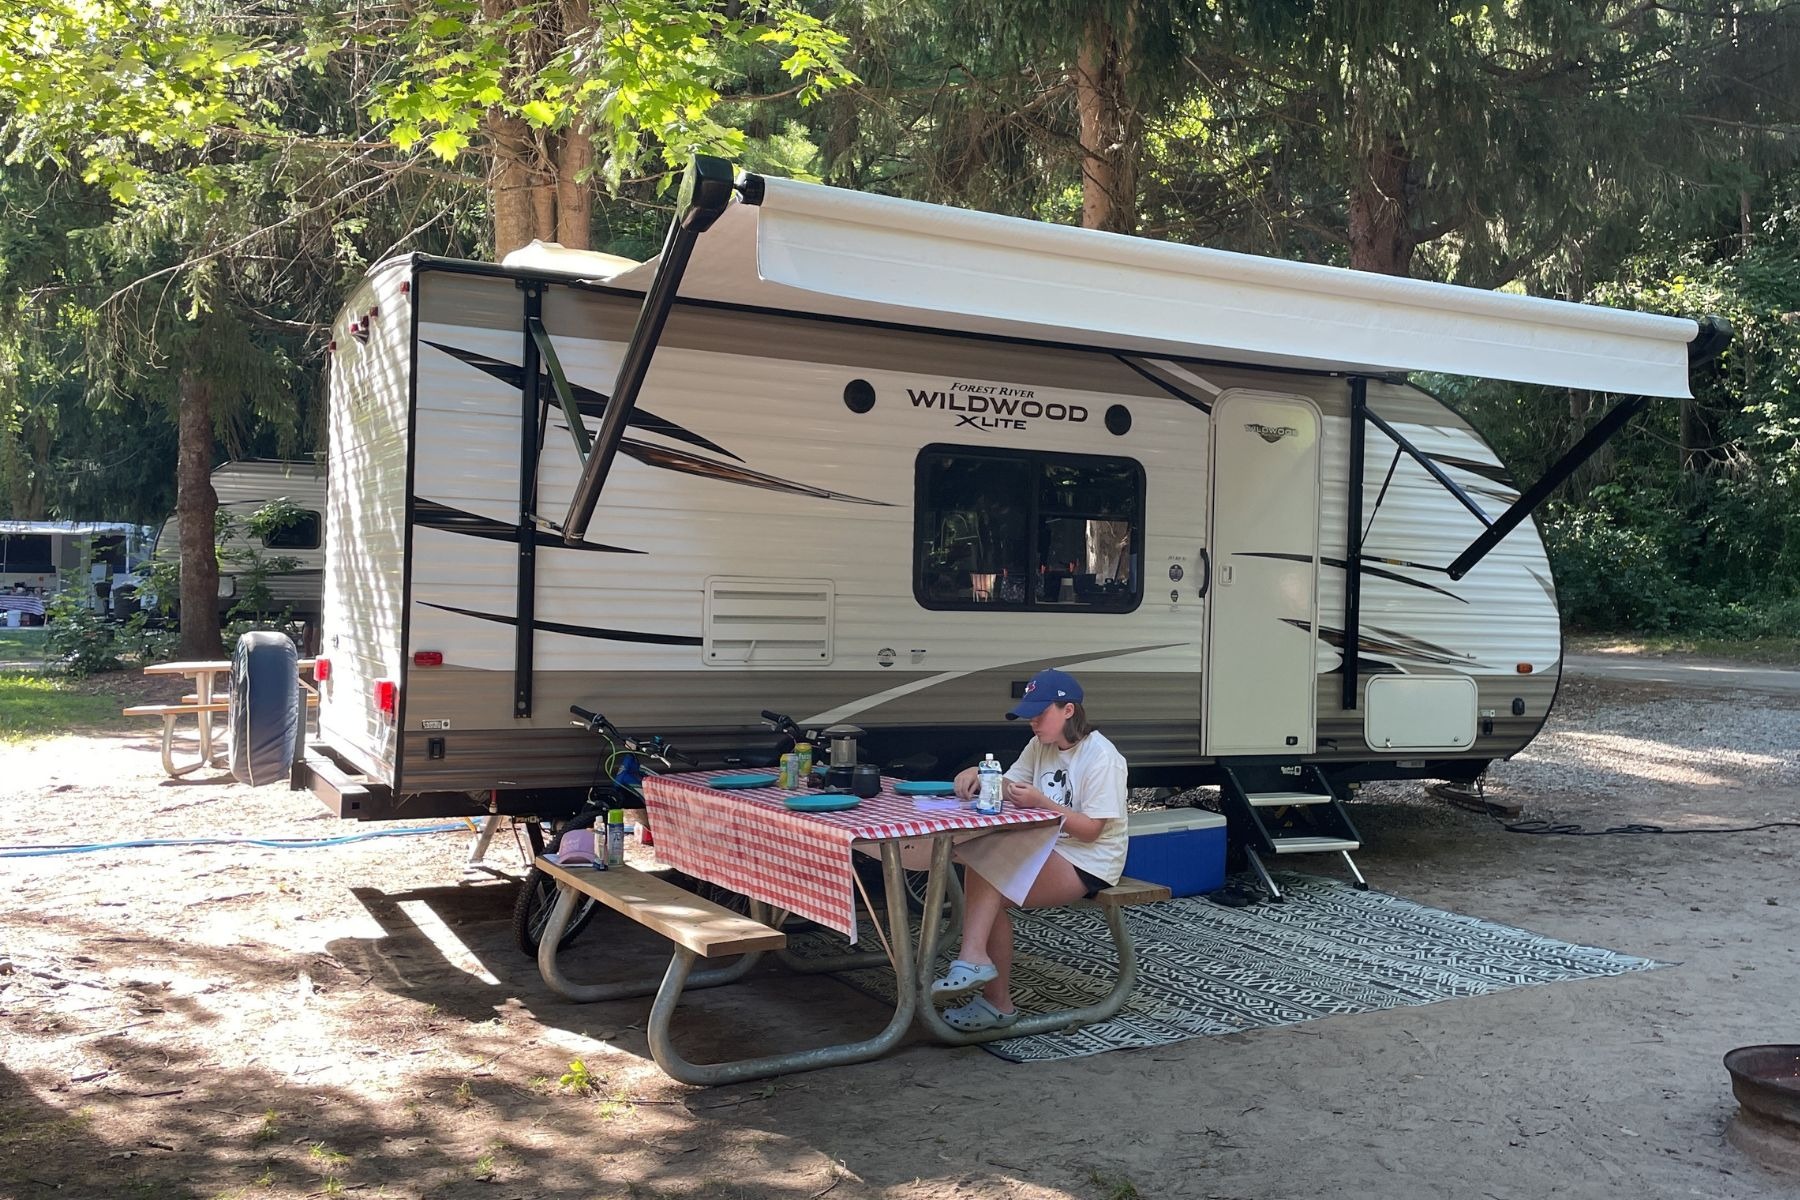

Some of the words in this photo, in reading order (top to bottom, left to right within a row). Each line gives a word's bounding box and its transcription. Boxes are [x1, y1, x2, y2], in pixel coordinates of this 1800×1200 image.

[950, 382, 1000, 396] FOREST
[999, 387, 1035, 399] RIVER
[906, 388, 1089, 423] WILDWOOD
